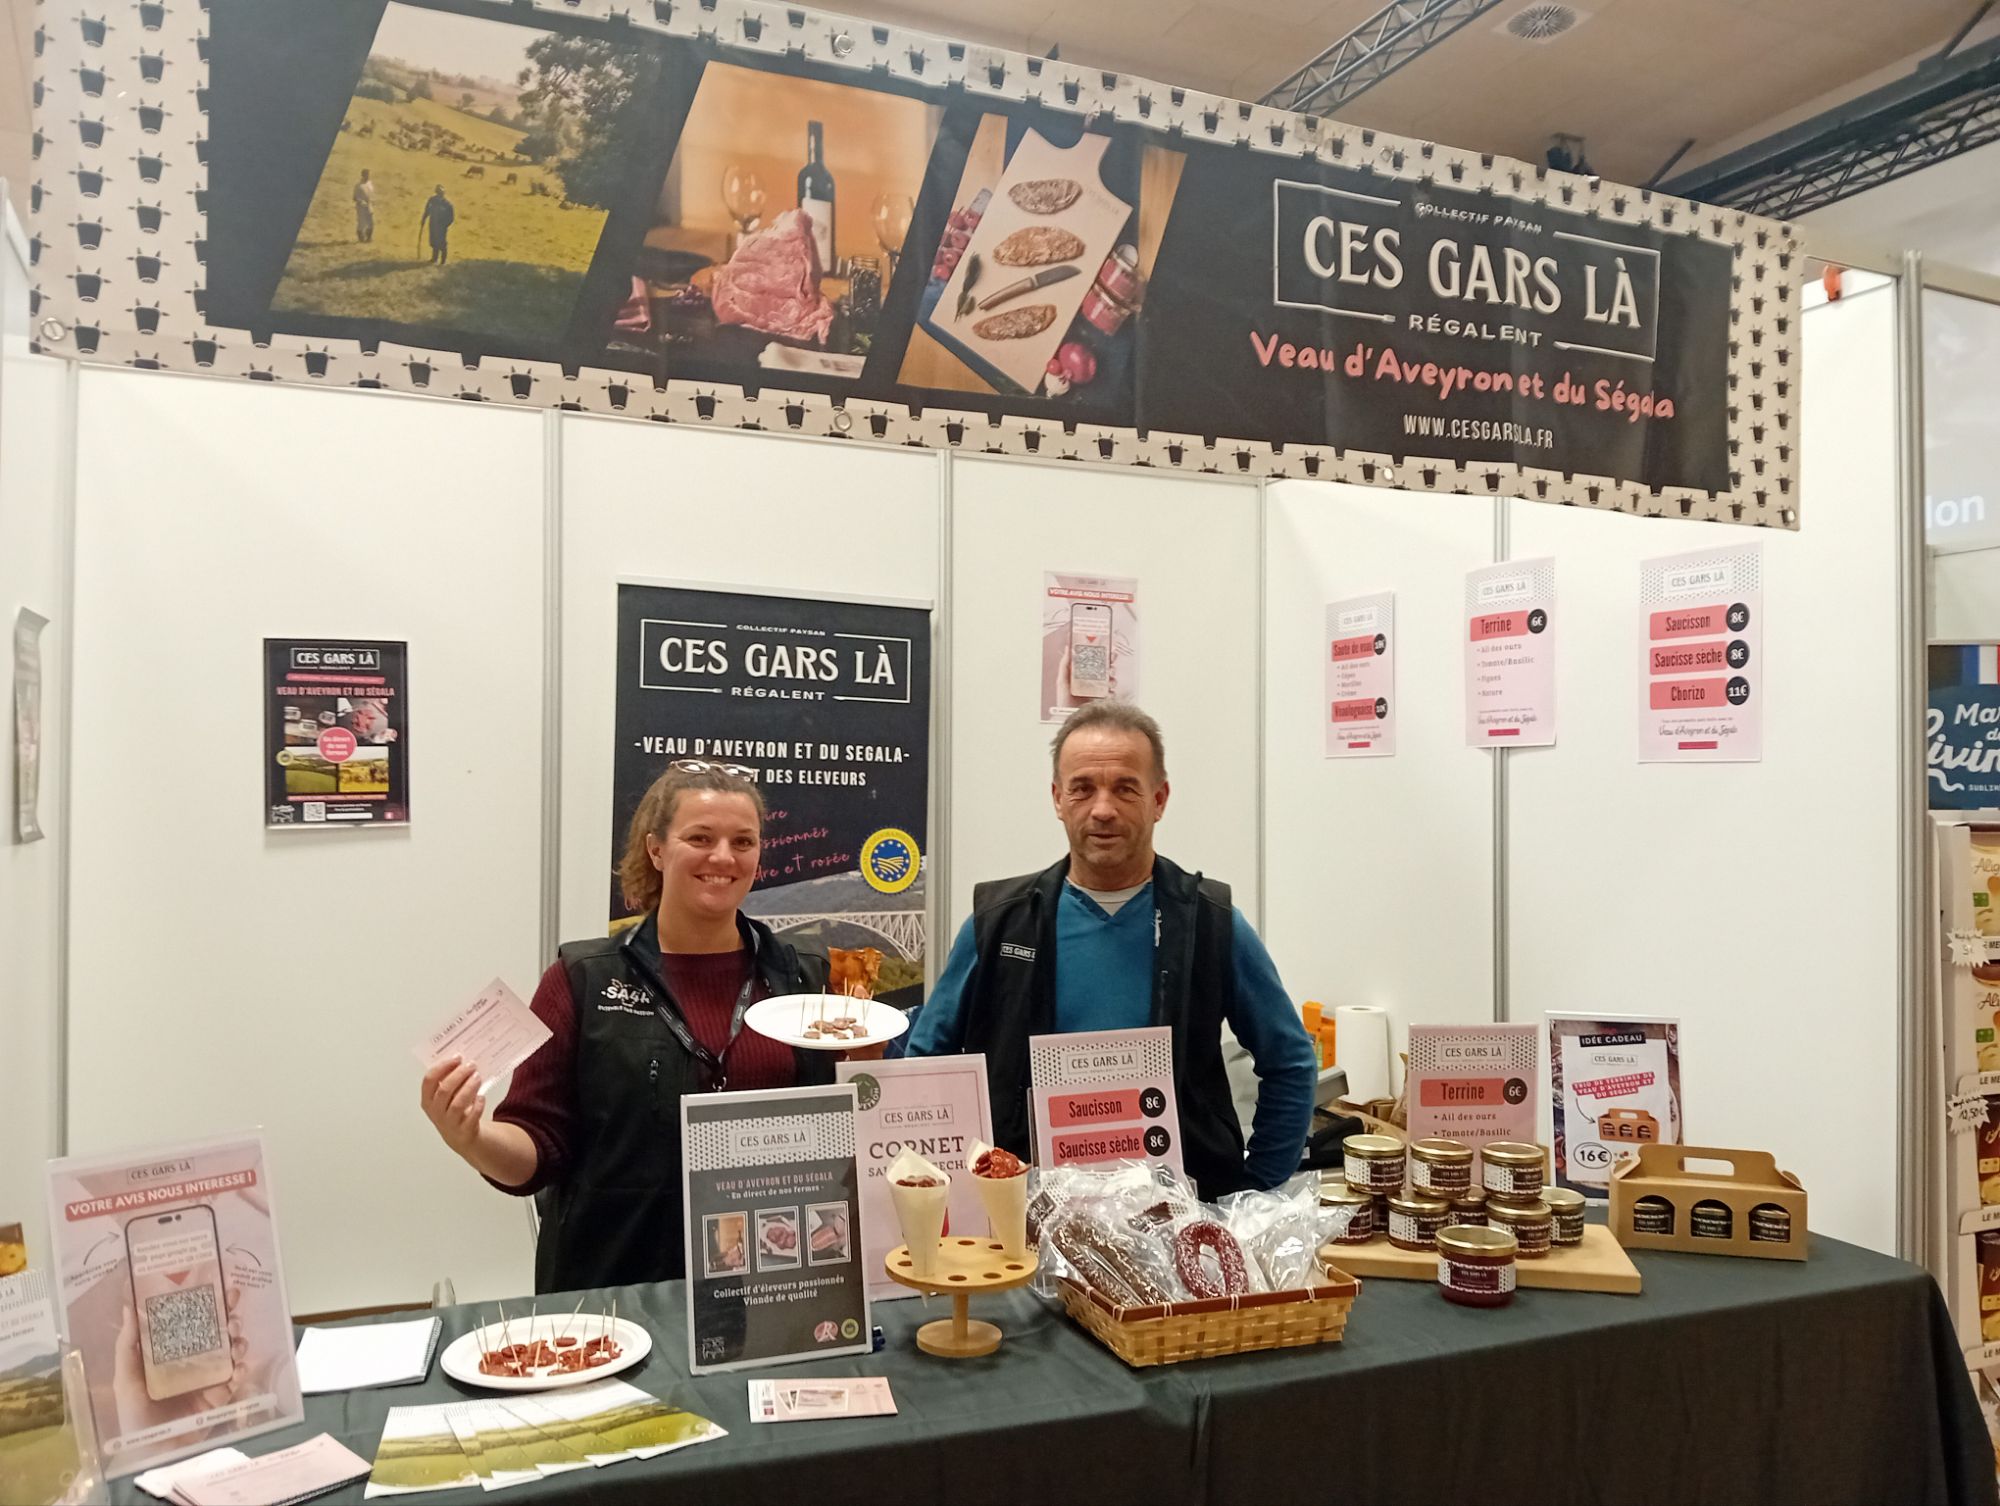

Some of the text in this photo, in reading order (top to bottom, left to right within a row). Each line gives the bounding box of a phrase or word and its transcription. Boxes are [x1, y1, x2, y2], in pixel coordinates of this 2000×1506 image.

[1415, 202, 1490, 225] COLLECTIF
[1304, 214, 1643, 329] CES GARS LÀ
[1408, 313, 1543, 347] RÉGALENT
[1250, 331, 1676, 424] Veau d'Aveyron et du Ségala
[1403, 413, 1554, 450] WWW.CESGARSLA.FR
[736, 623, 826, 637] COLLECTIF PAYSAN
[1481, 615, 1543, 635] Terrine 6€
[1665, 611, 1745, 632] Saucisson 8€
[296, 651, 375, 665] CES GARS LÀ
[659, 636, 897, 686] CES GARS LÀ
[1654, 647, 1745, 668] Saucisse sèche 8€
[731, 684, 826, 701] RÉGALENT
[1670, 684, 1748, 702] Chorizo 11€
[694, 738, 788, 760] D'AVEYRON
[794, 742, 813, 760] ET
[819, 743, 840, 761] DU
[766, 768, 793, 784] DES
[798, 769, 867, 787] ELEVEURS
[760, 827, 829, 850] ssionnés
[784, 853, 804, 874] et
[1581, 1034, 1642, 1045] IDÉE CADEAU
[1071, 1052, 1134, 1070] CES GARS LÀ
[1445, 1048, 1462, 1058] CES
[1465, 1047, 1488, 1058] GARS
[1440, 1081, 1522, 1101] Terrine 6€
[884, 1107, 949, 1124] CES GARS LÀ
[1068, 1096, 1160, 1119] Saucisson 8€
[1441, 1112, 1497, 1121] Ail des ours
[740, 1135, 759, 1148] CES
[763, 1133, 790, 1146] GARS
[793, 1129, 806, 1142] LÀ
[1441, 1127, 1512, 1138] Tomate/Basilic
[1058, 1133, 1165, 1159] Saucisse sèche 8€
[131, 1167, 149, 1180] CES
[151, 1164, 176, 1177] GARS
[932, 1160, 968, 1172] ECH
[715, 1180, 736, 1192] VEAU
[738, 1175, 780, 1189] D'AVEYRON
[782, 1174, 791, 1186] ET
[793, 1173, 804, 1184] DU
[731, 1184, 820, 1200] En direct de nos fermes
[69, 1197, 113, 1216] VOTRE
[114, 1191, 145, 1208] AVIS
[147, 1184, 184, 1201] NOUS
[185, 1173, 246, 1195] INTERESSE
[713, 1274, 845, 1300] Collectif d'éleveurs passionnés
[743, 1288, 818, 1307] Viande de qualité
